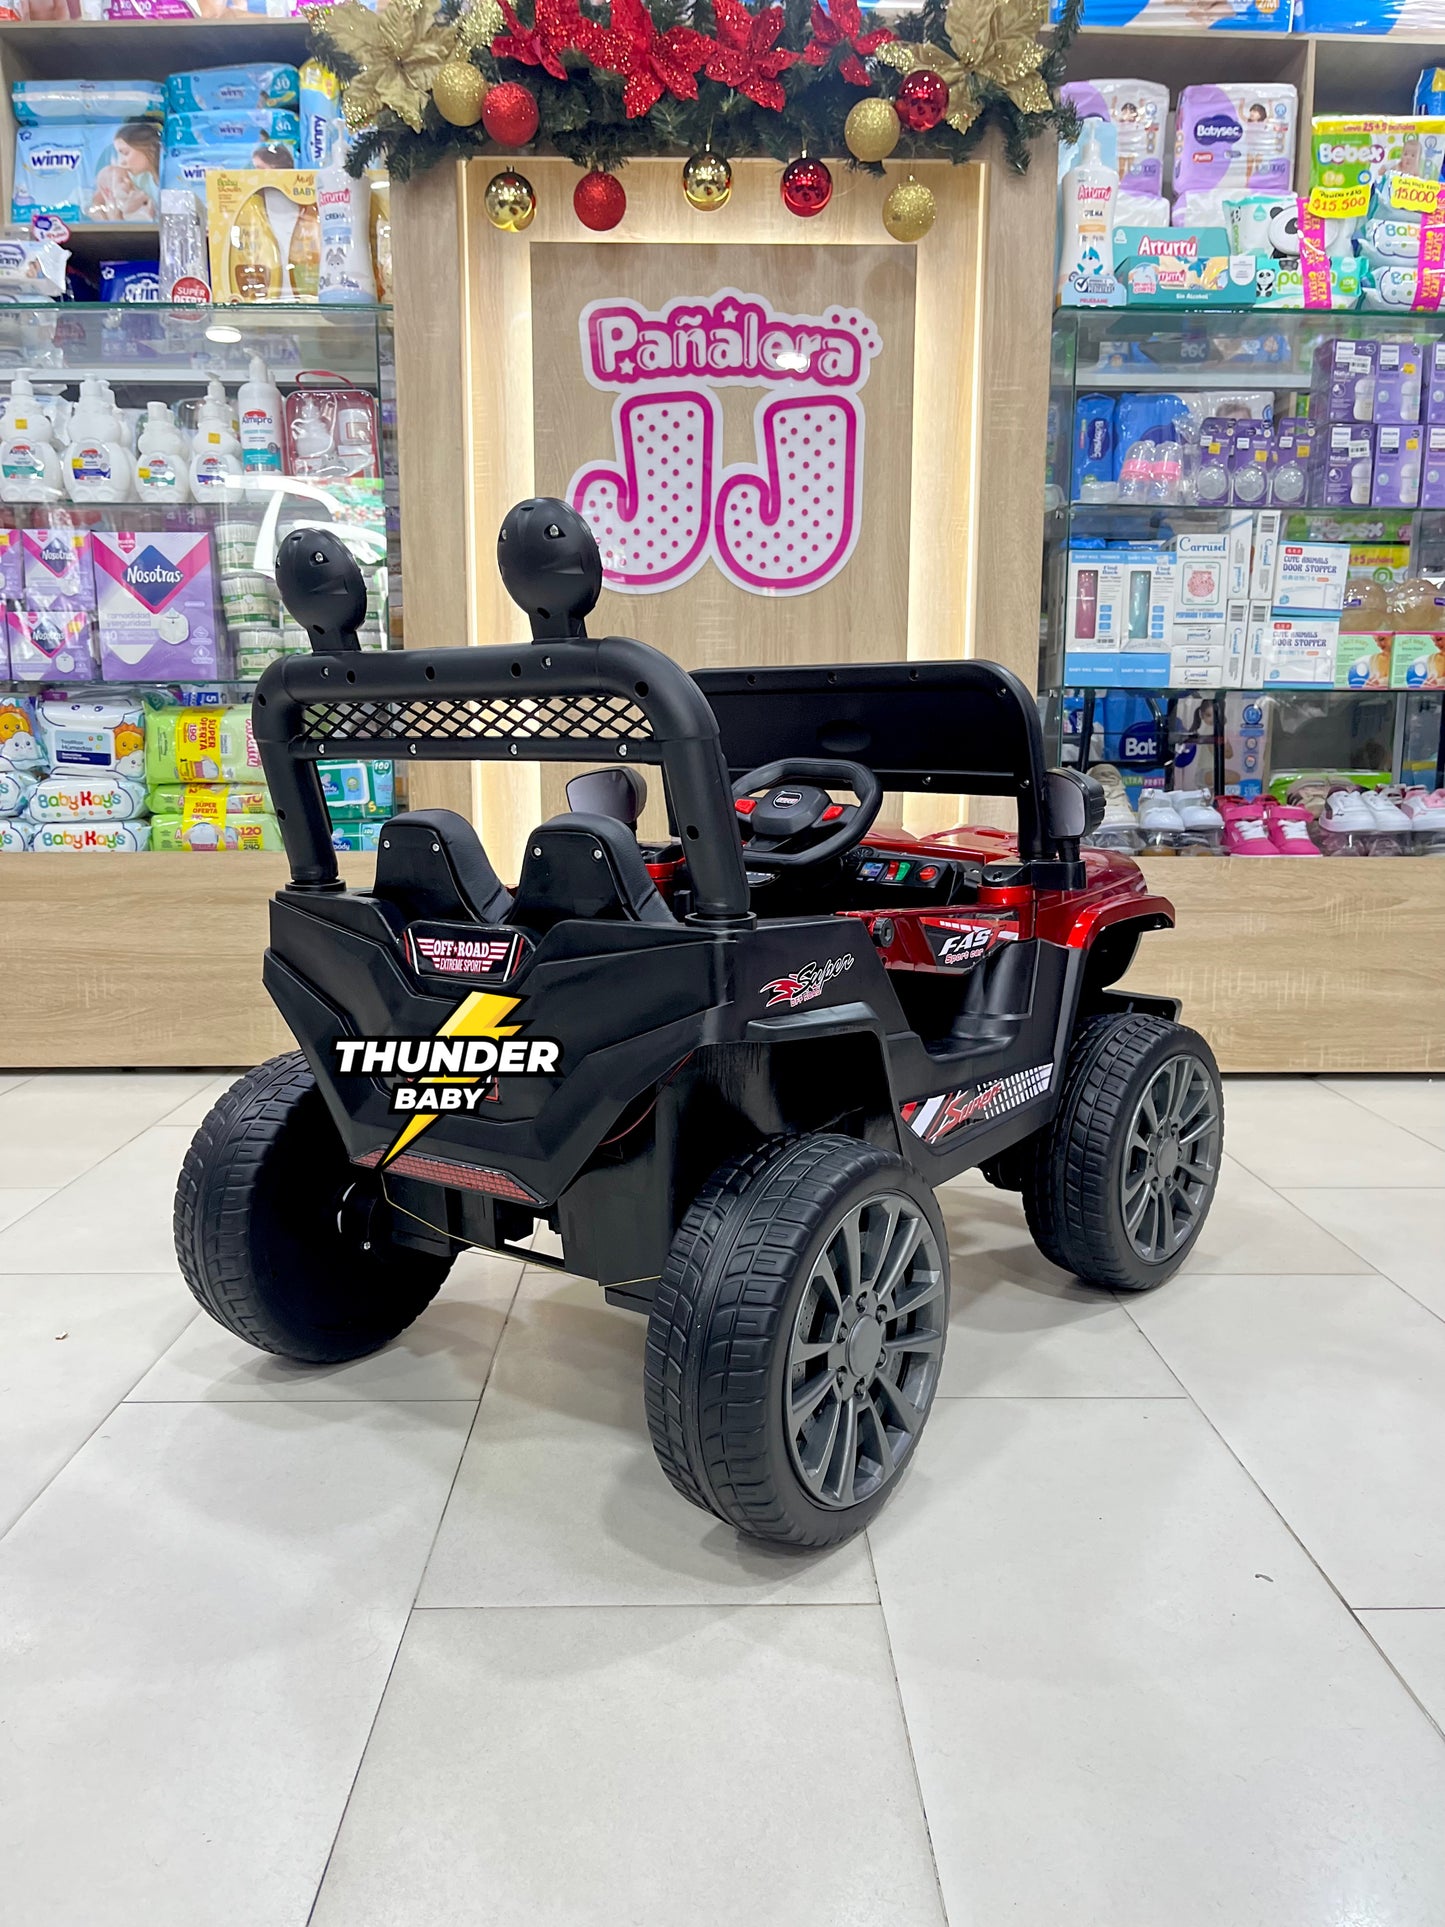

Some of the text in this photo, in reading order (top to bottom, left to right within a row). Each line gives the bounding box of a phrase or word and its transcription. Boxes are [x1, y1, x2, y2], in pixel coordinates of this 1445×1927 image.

[311, 115, 327, 159] winny
[1196, 125, 1240, 139] Babysec
[31, 150, 80, 170] winny
[1318, 143, 1385, 165] Bebex
[293, 187, 317, 201] BABY
[1385, 224, 1421, 240] Bab
[0, 254, 22, 270] inny
[597, 311, 855, 379] Pañalera
[1179, 536, 1226, 552] Carrusel
[127, 565, 184, 584] Nosotras
[1283, 563, 1337, 574] DOOR STOPPER
[1294, 639, 1327, 647] STOPPER
[189, 724, 198, 743] 190
[200, 717, 209, 751] OFERTA
[374, 761, 390, 771] 100
[38, 790, 122, 815] Baby Kay's
[42, 829, 126, 850] Baby Kay's
[241, 826, 263, 836] 120
[433, 939, 490, 958] OFF ROAD
[938, 924, 1006, 957] FAST
[440, 957, 482, 973] EXTREME SPORT
[945, 948, 984, 965] Sport car
[792, 953, 855, 999] Super
